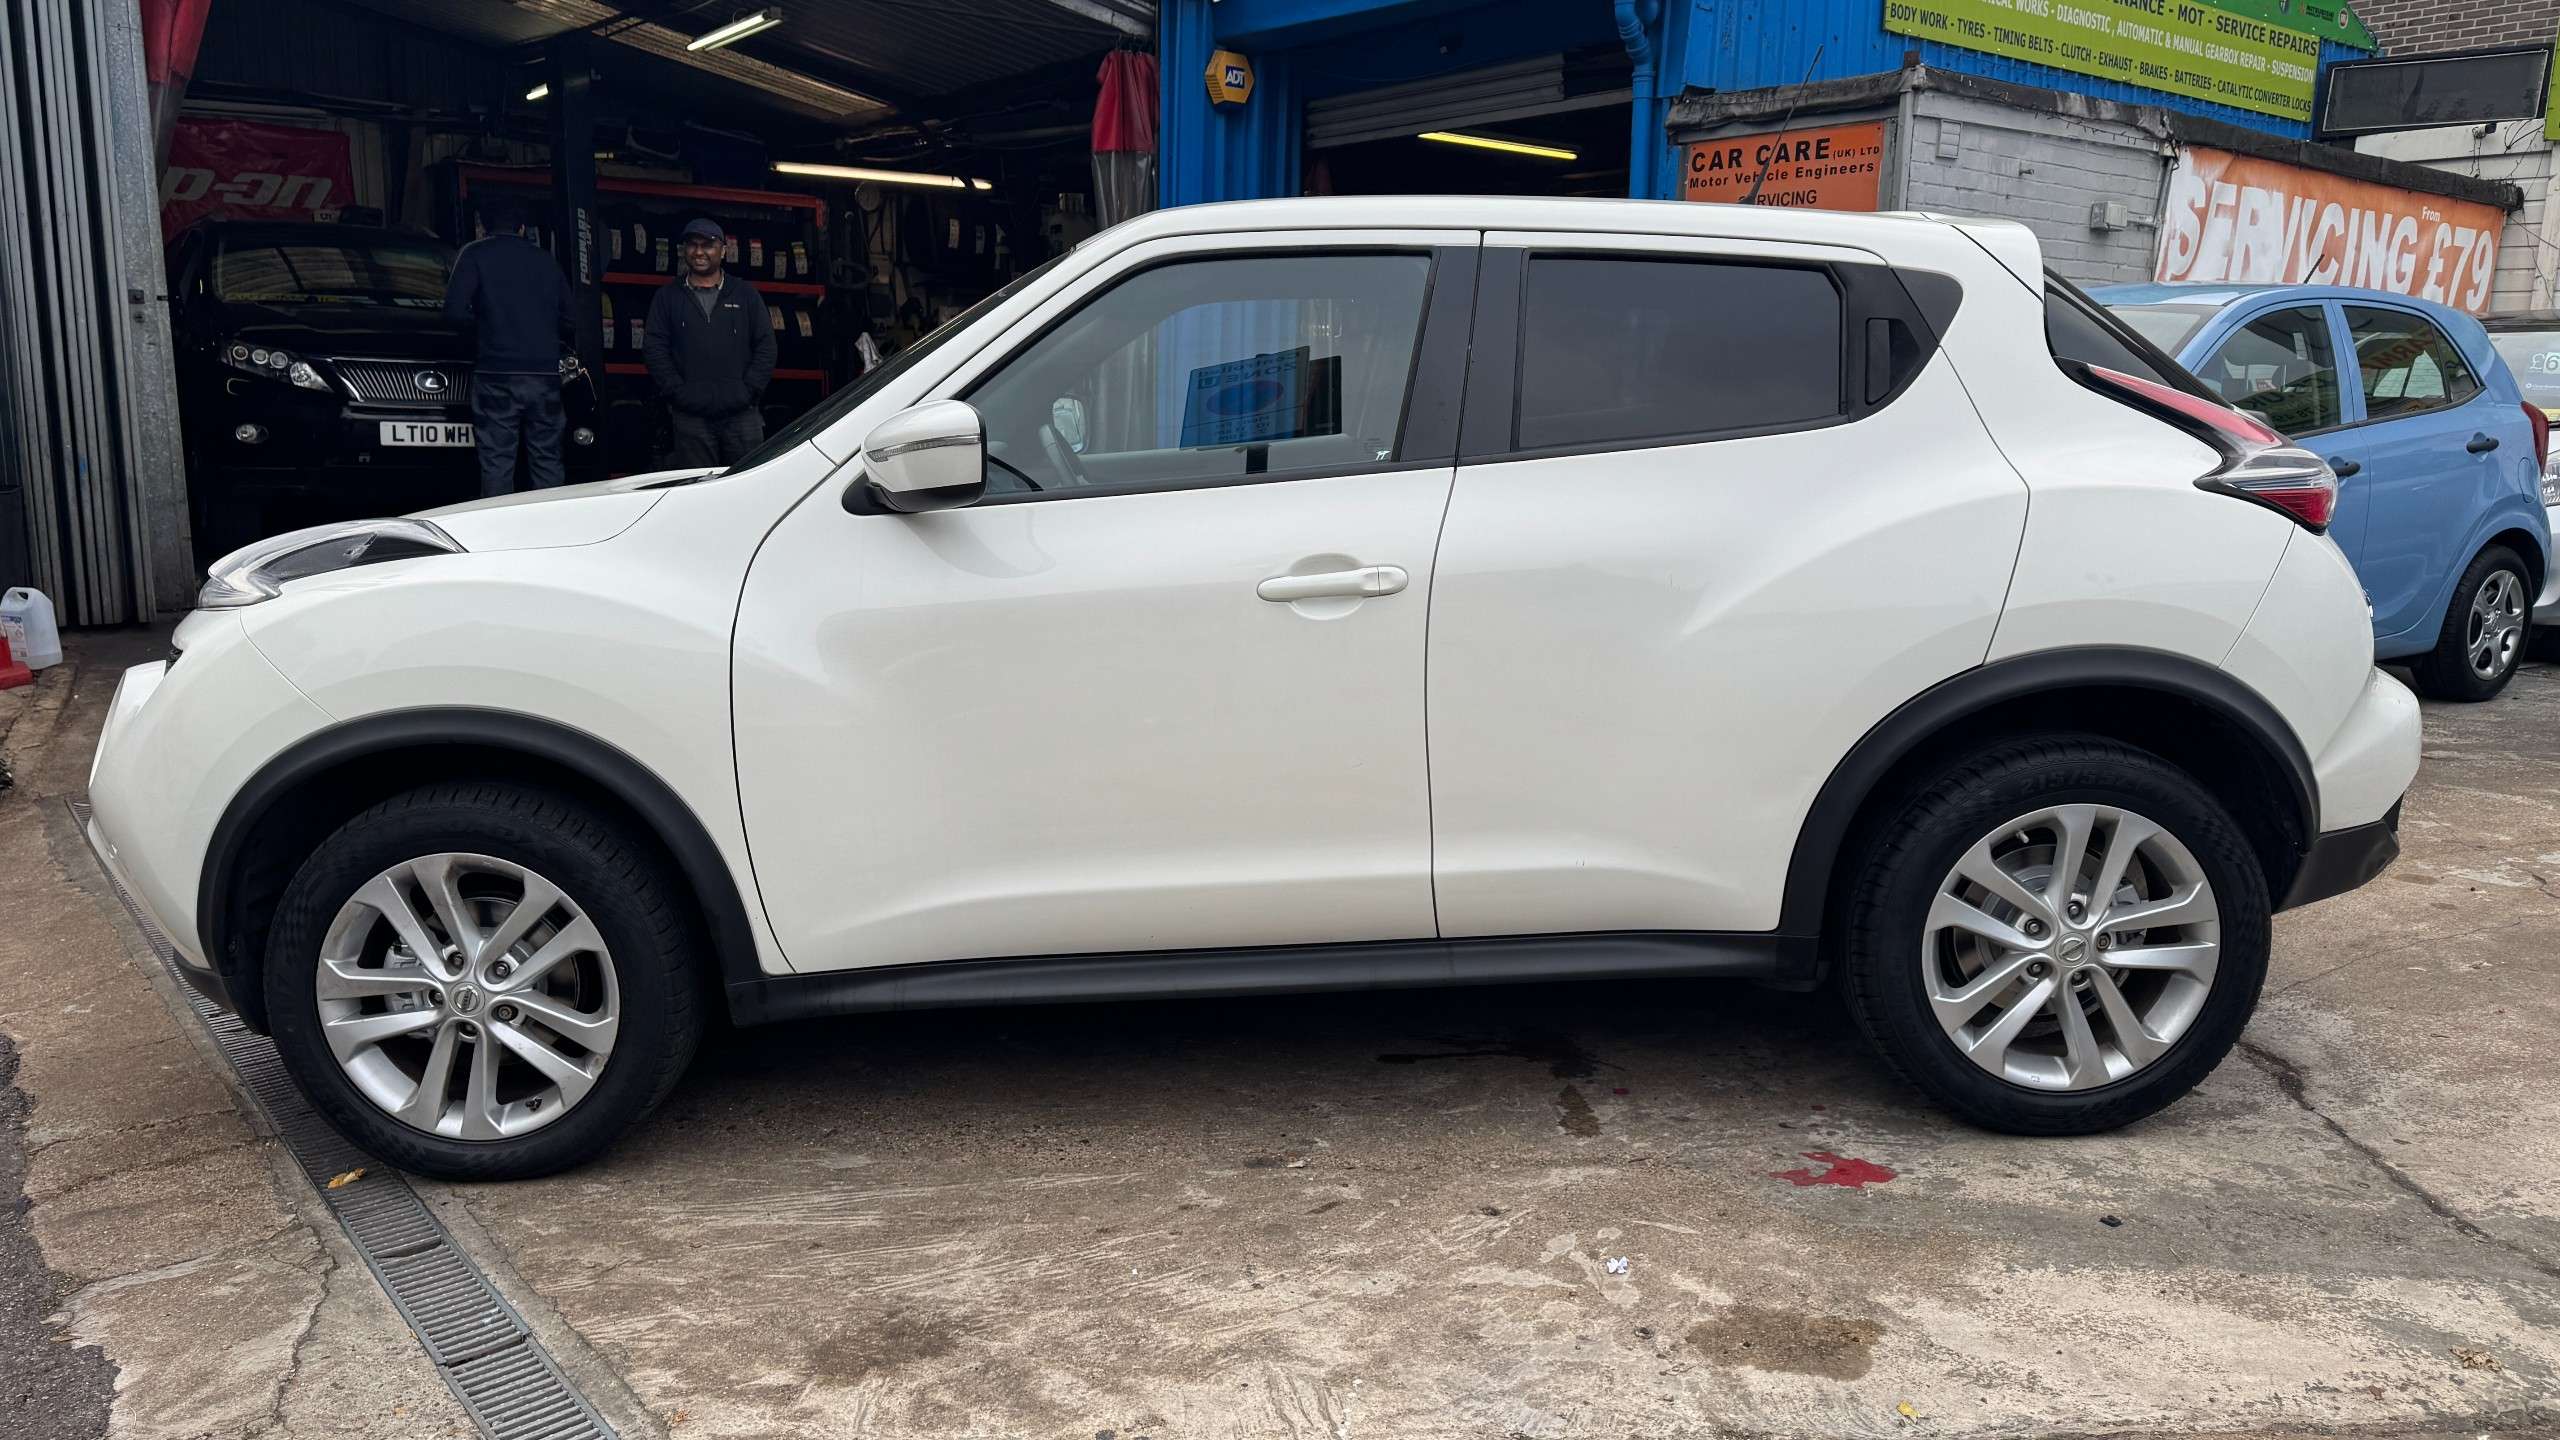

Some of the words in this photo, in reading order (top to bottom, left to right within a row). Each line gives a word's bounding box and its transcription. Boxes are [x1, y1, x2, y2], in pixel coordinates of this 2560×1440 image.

[2016, 0, 2048, 17] WORKS
[2056, 4, 2112, 33] DIAGNOSTIC
[2117, 20, 2163, 47] AUTOMATIC
[2174, 34, 2203, 57] MANUAL
[2205, 43, 2238, 65] GEARBOX
[2240, 52, 2266, 71] REPAIR
[2271, 59, 2314, 83] SUSPENSION
[2178, 4, 2205, 26] MOT
[2216, 15, 2265, 43] SERVICE
[2269, 29, 2318, 57] REPAIRS
[1890, 3, 1918, 22] BODY
[1920, 11, 1948, 30] WORK
[1957, 18, 1985, 39] TYRES
[1993, 26, 2026, 47] TIMING
[2028, 35, 2053, 53] BELTS
[2061, 43, 2091, 62] CLUTCH
[2099, 52, 2133, 72] EXHAUST
[2139, 61, 2168, 80] BRAKES
[2174, 70, 2212, 90] BATTERIES
[2217, 80, 2253, 101] CATALYTIC
[2254, 87, 2291, 106] CONVERTER
[2291, 96, 2311, 113] LOCKS
[1225, 68, 1245, 86] ADT
[1691, 148, 1743, 173] CAR
[1755, 138, 1831, 166] CARE
[1832, 149, 1856, 161] (UK)
[1860, 146, 1880, 156] LTD
[1690, 176, 1729, 189] Motor
[1735, 169, 1788, 183] Vehcle
[1795, 162, 1875, 179] Engineers
[1738, 189, 1817, 206] RVICING
[2421, 206, 2441, 222] From
[2166, 174, 2419, 295] SERVICING
[2421, 222, 2493, 311] £79
[392, 424, 438, 443] LT10
